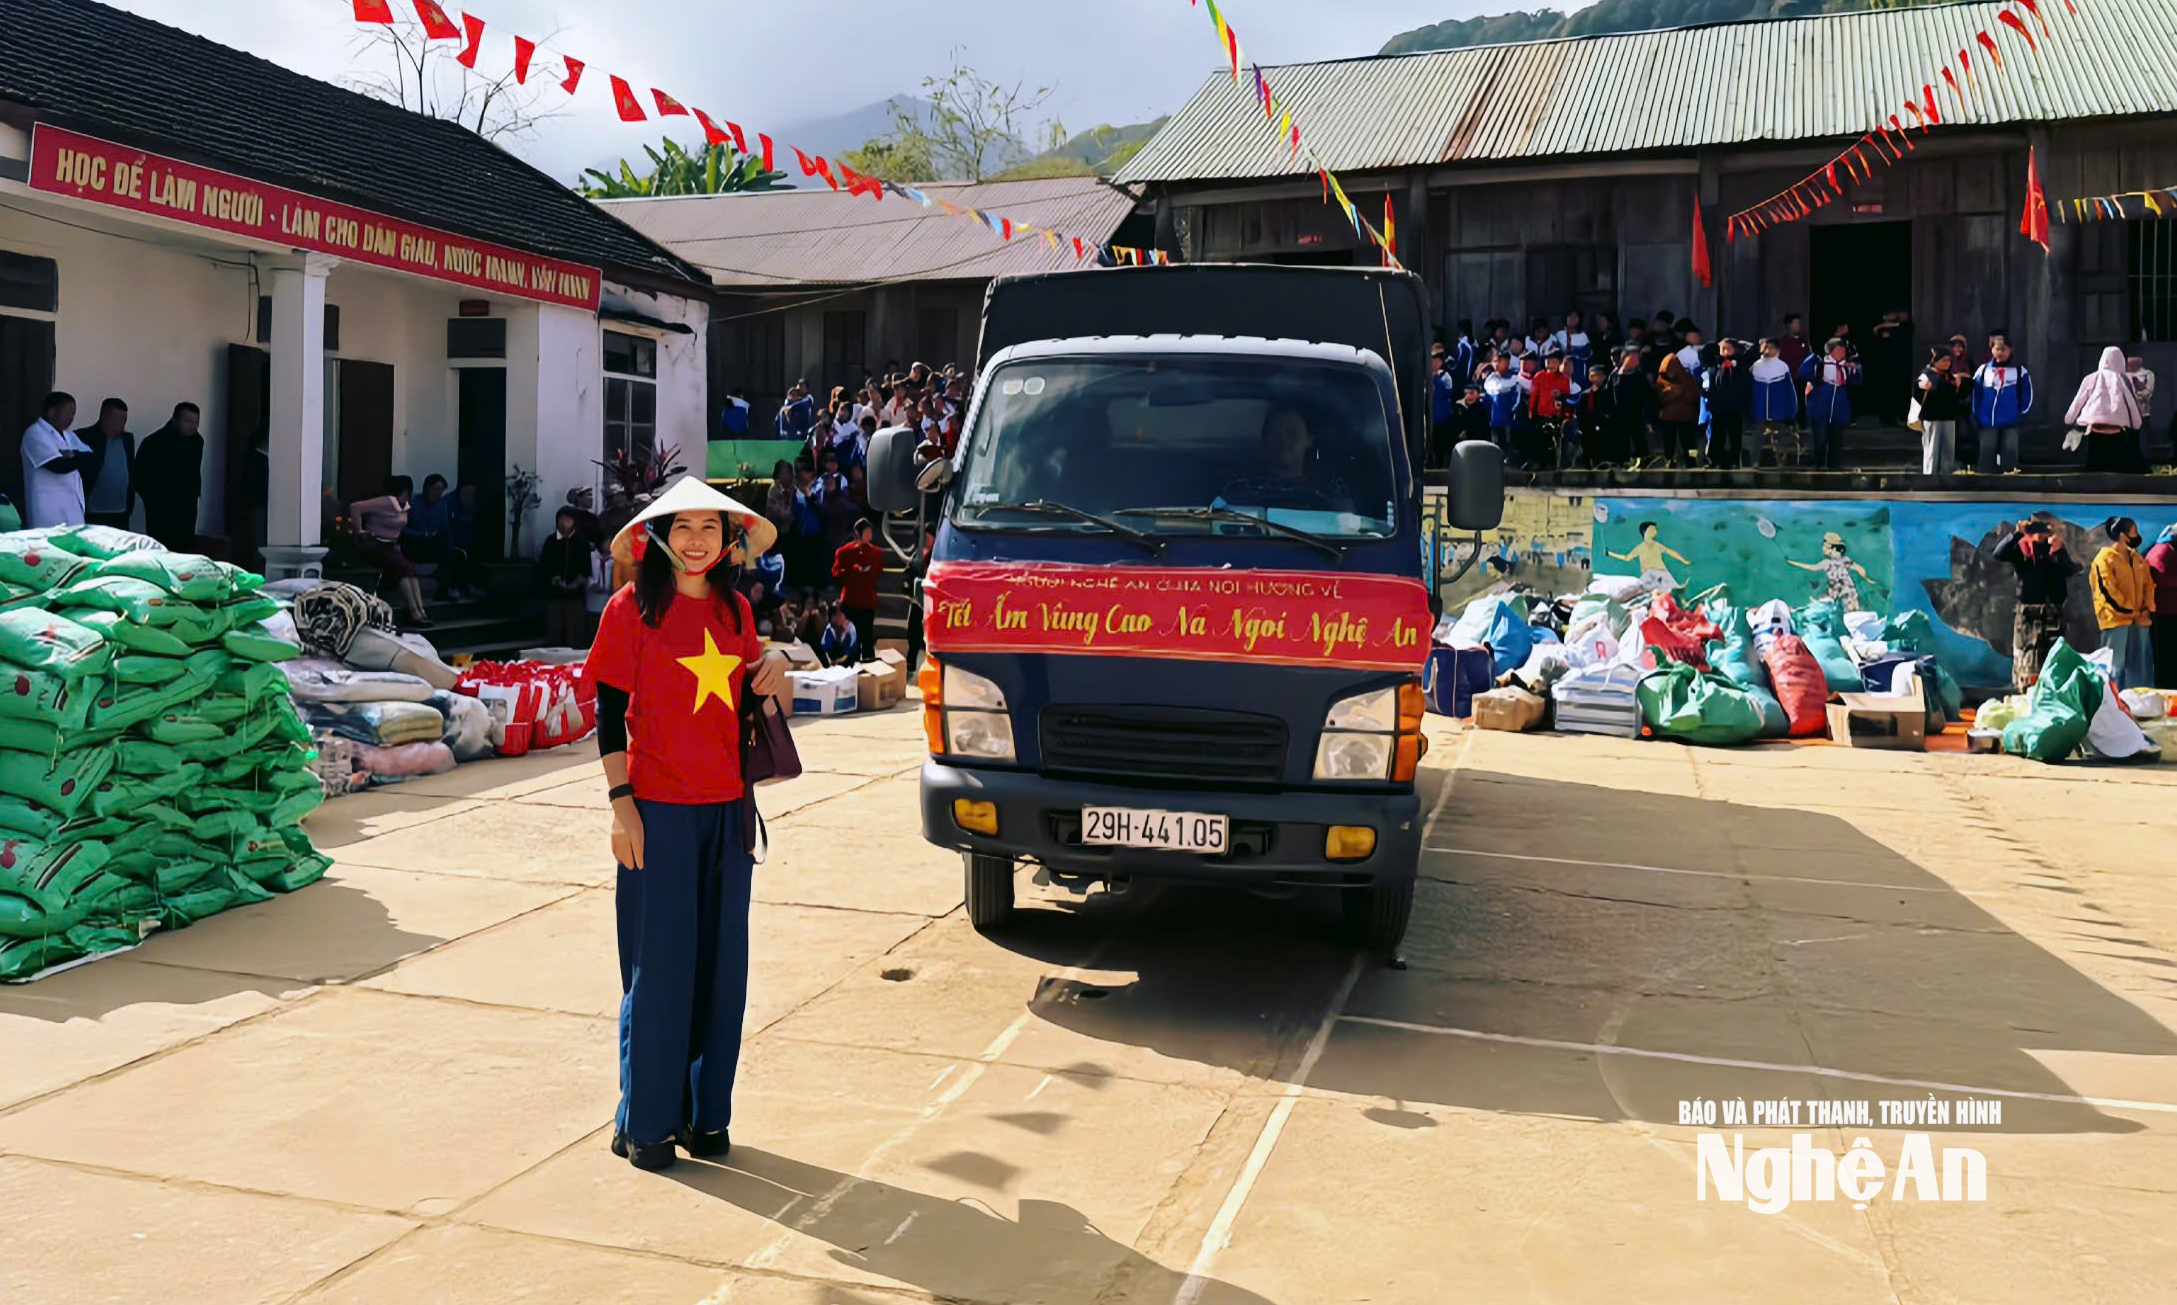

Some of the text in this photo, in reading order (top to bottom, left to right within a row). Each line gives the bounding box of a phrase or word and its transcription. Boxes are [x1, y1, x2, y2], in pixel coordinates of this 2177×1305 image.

[56, 148, 107, 193] HỌC
[149, 167, 197, 212] LÀM
[281, 201, 321, 240] LÀM
[325, 216, 359, 249] CHO
[1104, 603, 1153, 634] Cao
[1290, 609, 1369, 657] Nghệ
[1372, 617, 1417, 648] An
[1086, 810, 1223, 848] 29H-441.05
